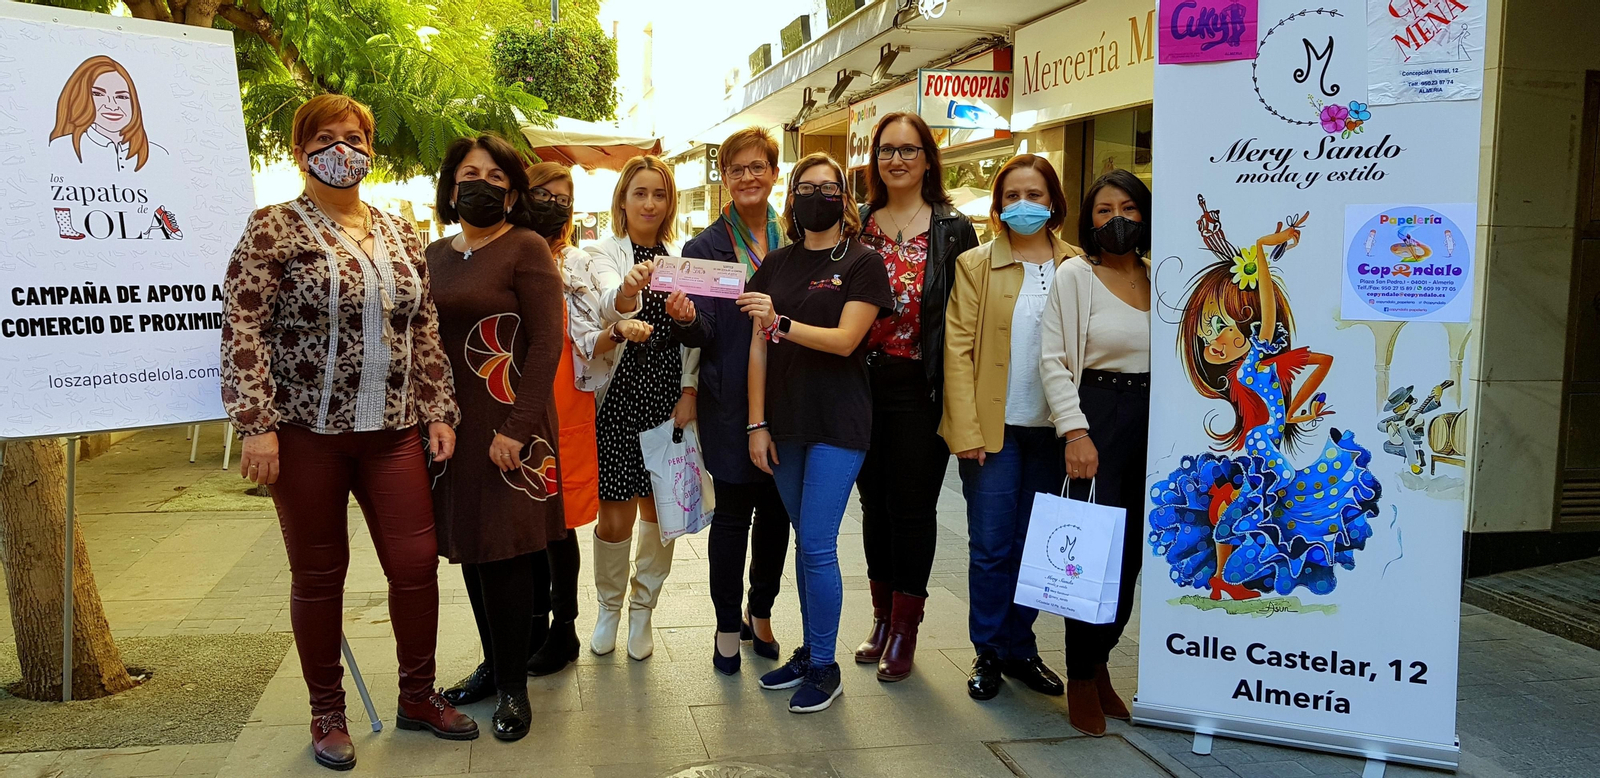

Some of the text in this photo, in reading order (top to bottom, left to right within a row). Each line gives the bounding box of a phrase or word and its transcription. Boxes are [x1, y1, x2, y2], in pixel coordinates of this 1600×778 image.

[1388, 0, 1431, 20] CA
[1391, 0, 1469, 62] MENA
[1022, 9, 1156, 96] Mercería M
[1293, 36, 1340, 96] M
[924, 75, 1009, 98] FOTOCOPIAS
[850, 102, 877, 125] Papelería
[1209, 134, 1407, 171] Mery Sando
[50, 173, 64, 183] los
[1235, 162, 1389, 190] moda y estilo
[51, 184, 148, 206] zapatos
[137, 205, 148, 214] de
[1380, 214, 1442, 226] Papelería
[11, 281, 112, 306] CAMPAÑA
[116, 285, 142, 304] DE
[147, 284, 206, 303] APOYO
[2, 315, 105, 338] COMERCIO
[109, 315, 135, 333] DE
[49, 366, 220, 388] loszapatosdelola.com
[1165, 633, 1428, 685] Calle Castelar, 12
[1231, 679, 1351, 714] Almería
